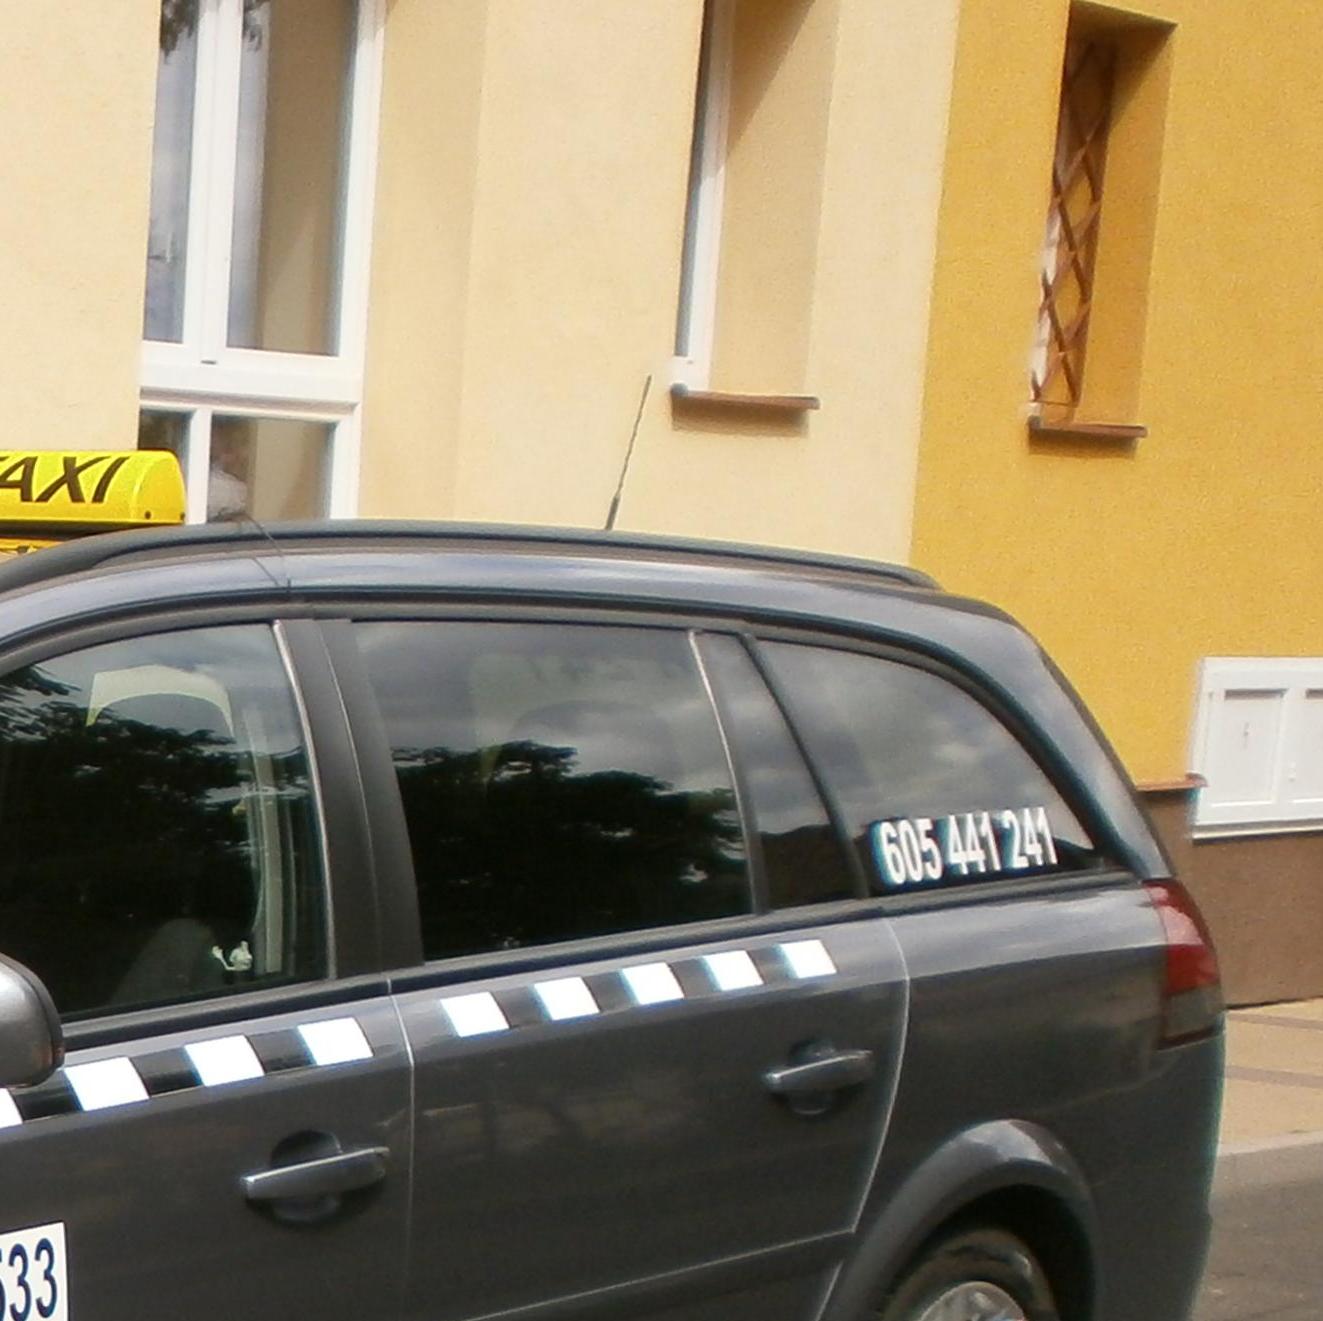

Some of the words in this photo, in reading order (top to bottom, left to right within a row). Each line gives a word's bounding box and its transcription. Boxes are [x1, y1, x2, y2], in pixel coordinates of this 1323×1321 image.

[878, 817, 944, 886] 605
[946, 811, 1002, 876] 441
[1003, 805, 1058, 870] 241
